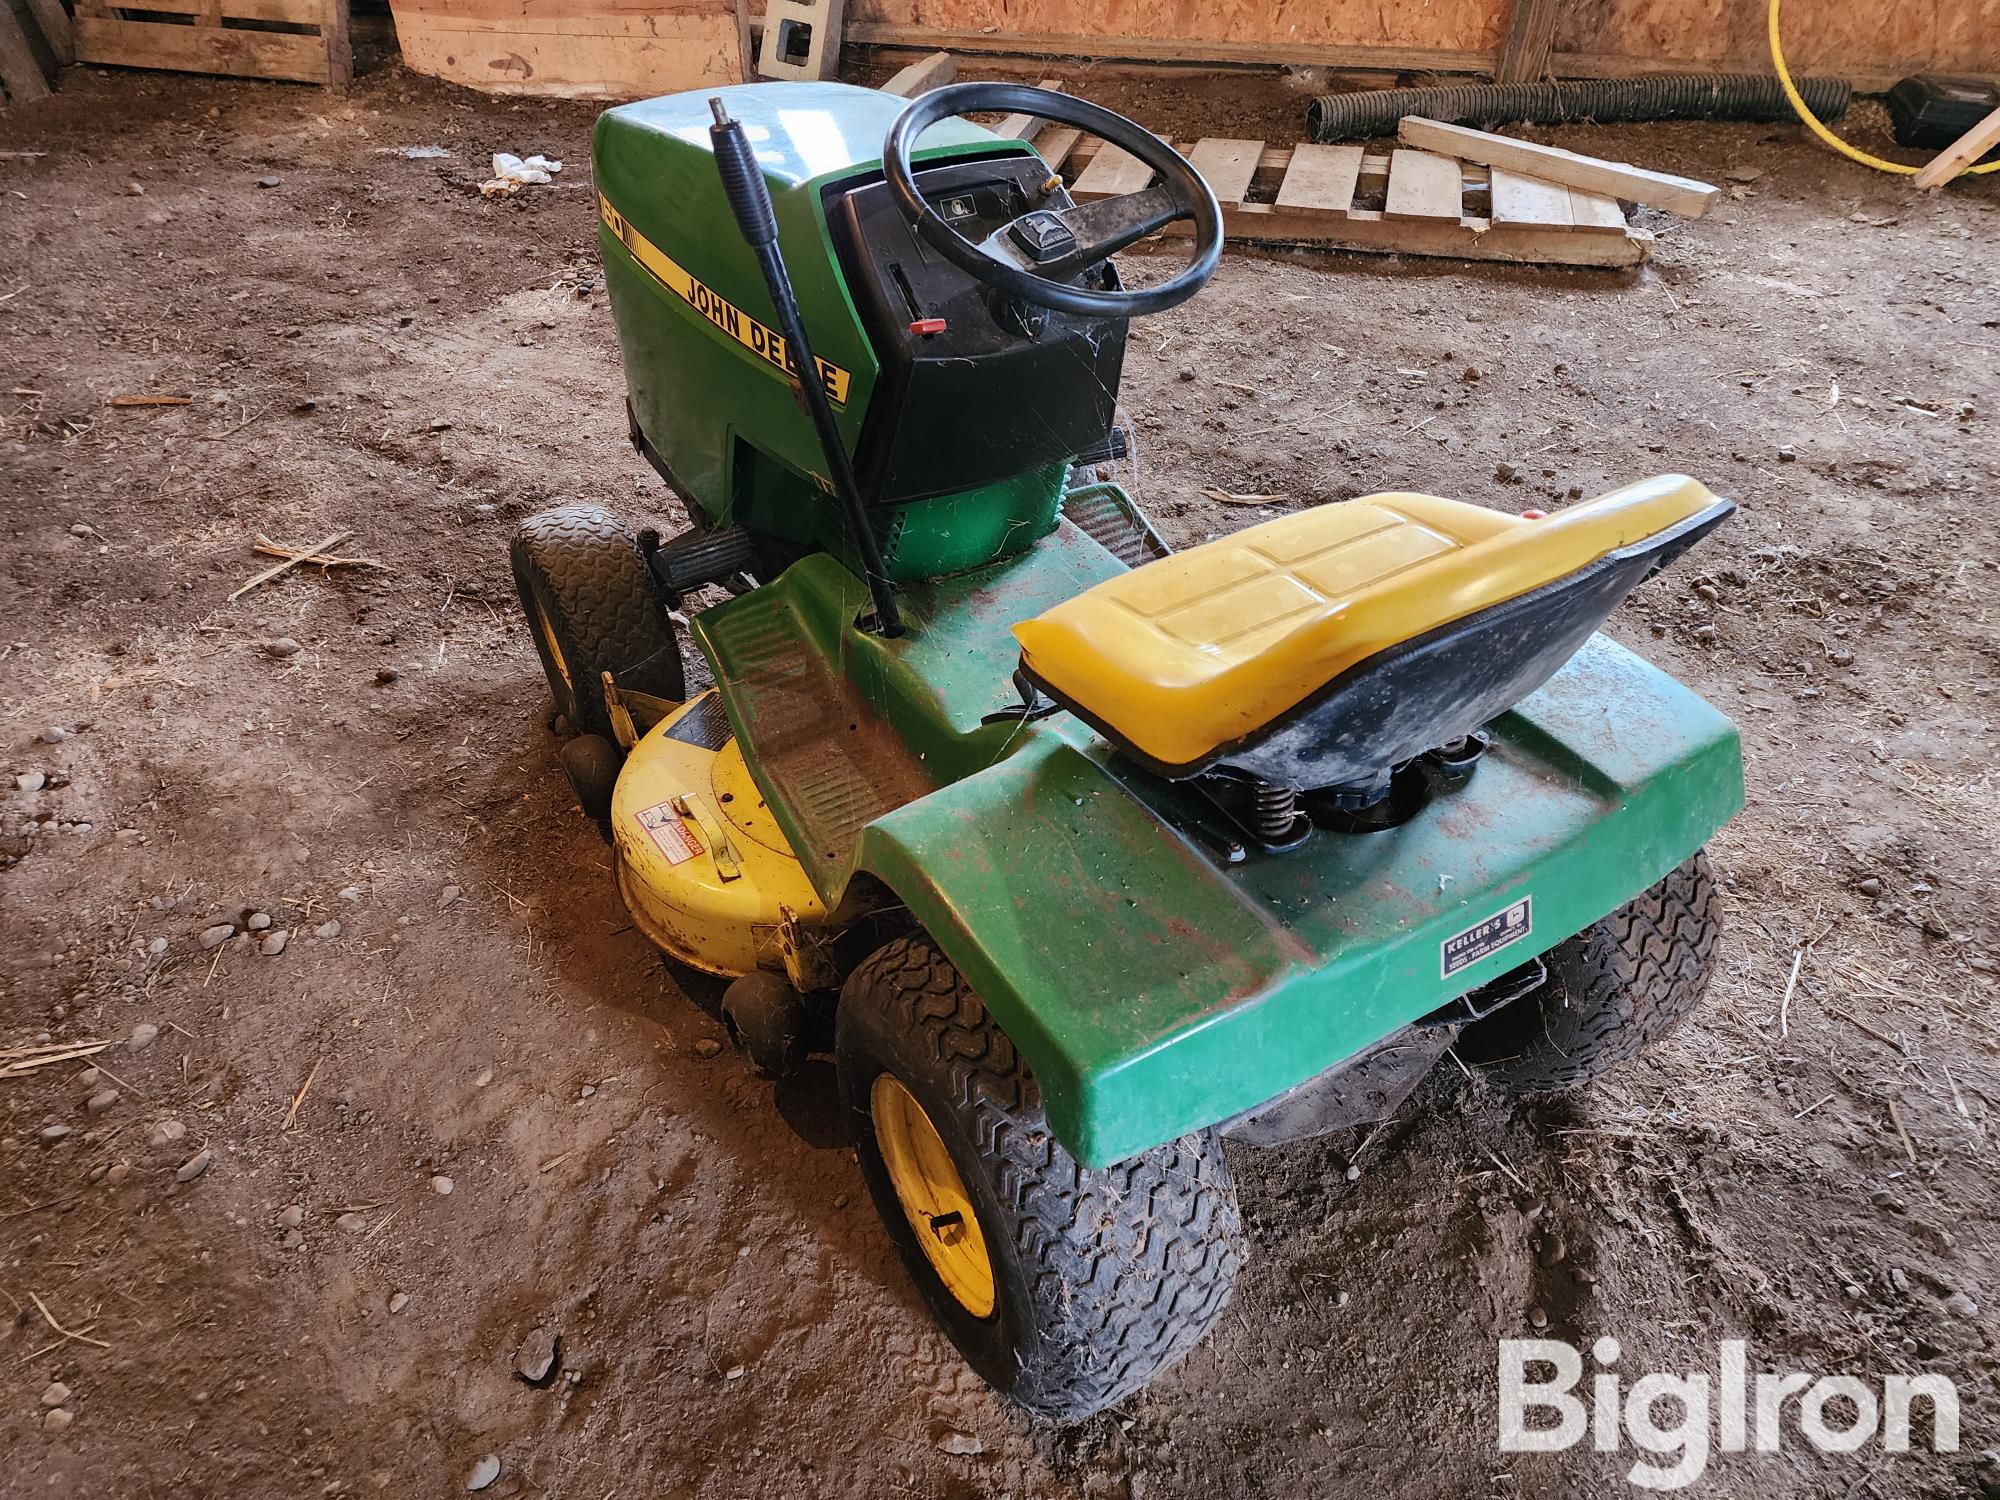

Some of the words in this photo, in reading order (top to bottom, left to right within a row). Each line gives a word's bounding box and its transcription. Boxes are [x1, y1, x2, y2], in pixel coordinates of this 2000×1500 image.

[687, 278, 740, 338] JOHN
[750, 321, 838, 398] DEE
[676, 825, 703, 855] DANGER
[1447, 918, 1501, 954] KELLER'S
[1471, 945, 1491, 959] FARM
